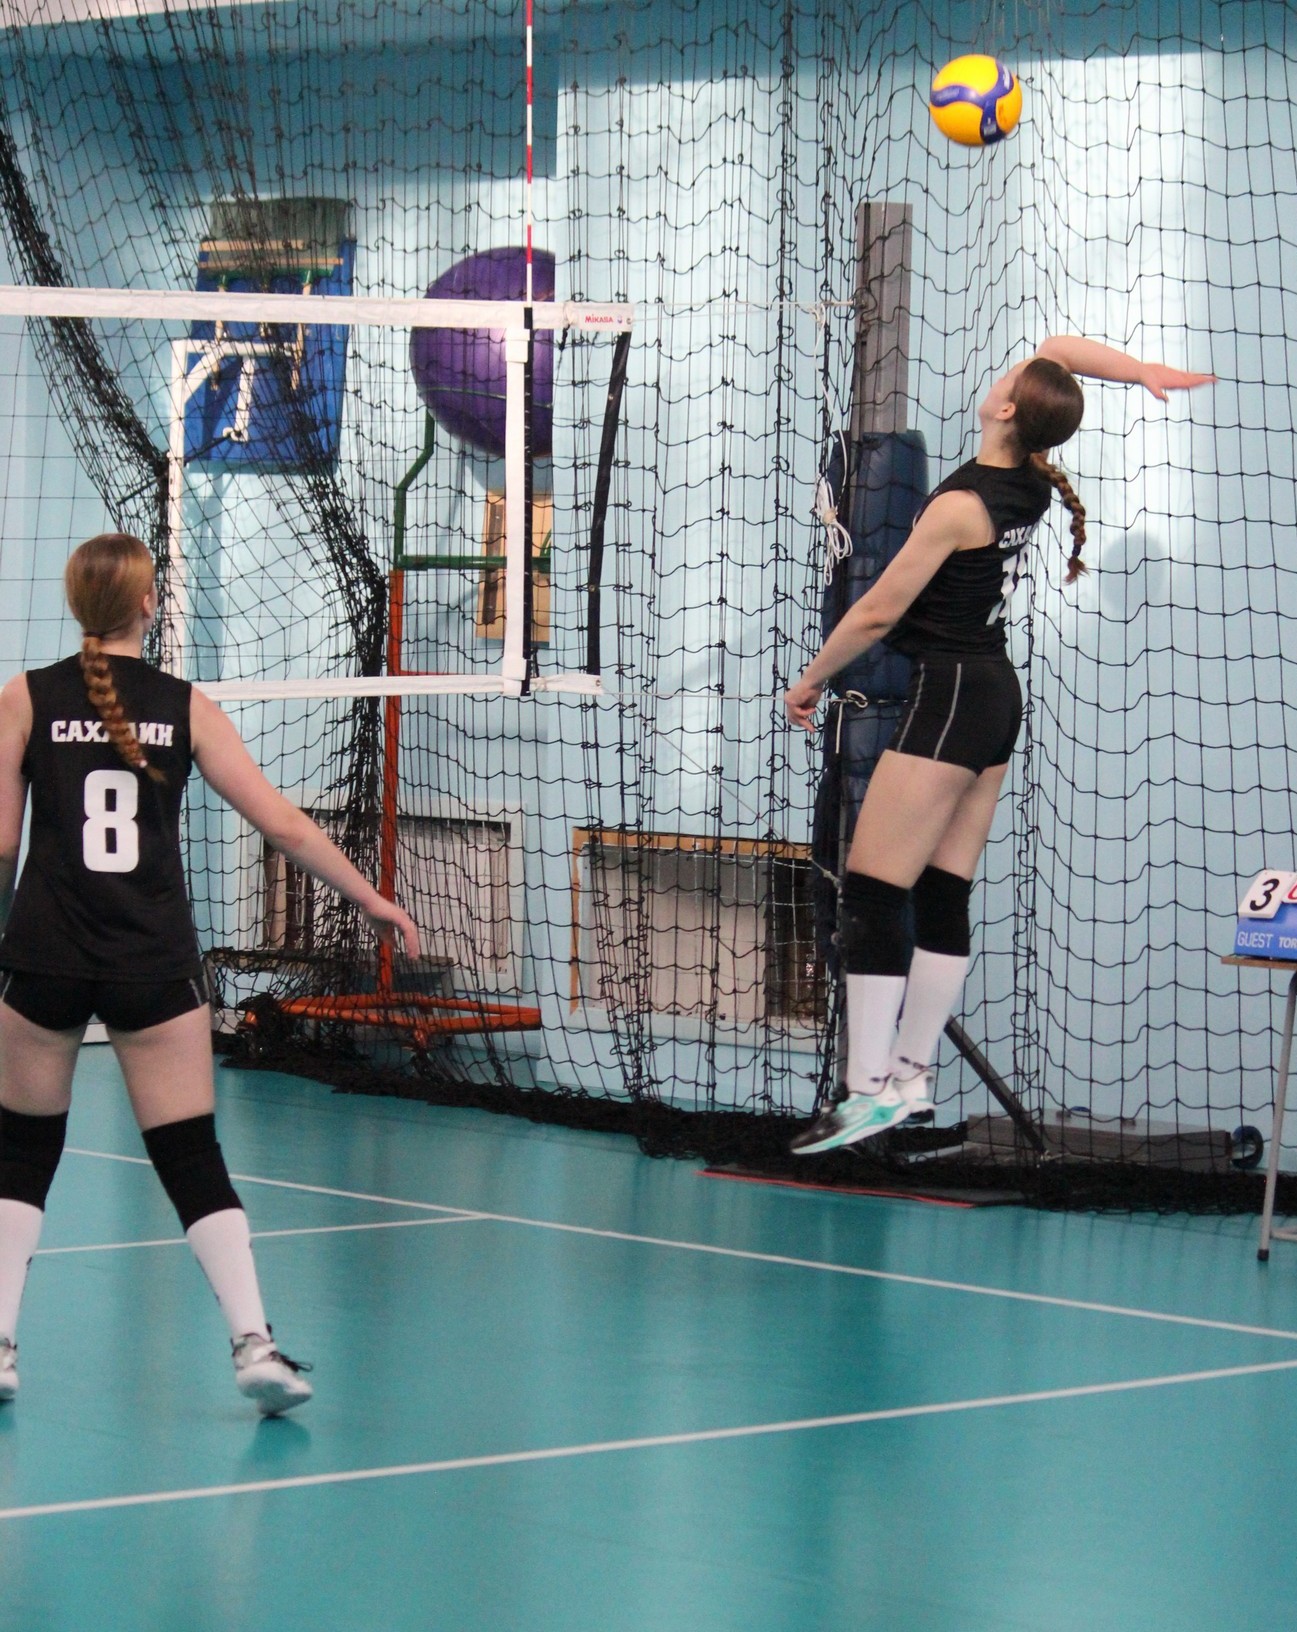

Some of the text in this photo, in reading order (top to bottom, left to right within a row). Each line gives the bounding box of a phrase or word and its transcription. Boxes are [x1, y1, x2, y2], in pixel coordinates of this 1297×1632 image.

[51, 720, 174, 747] САХИН
[83, 769, 140, 873] 8
[1249, 878, 1280, 911] 3
[1237, 931, 1274, 949] GUEST
